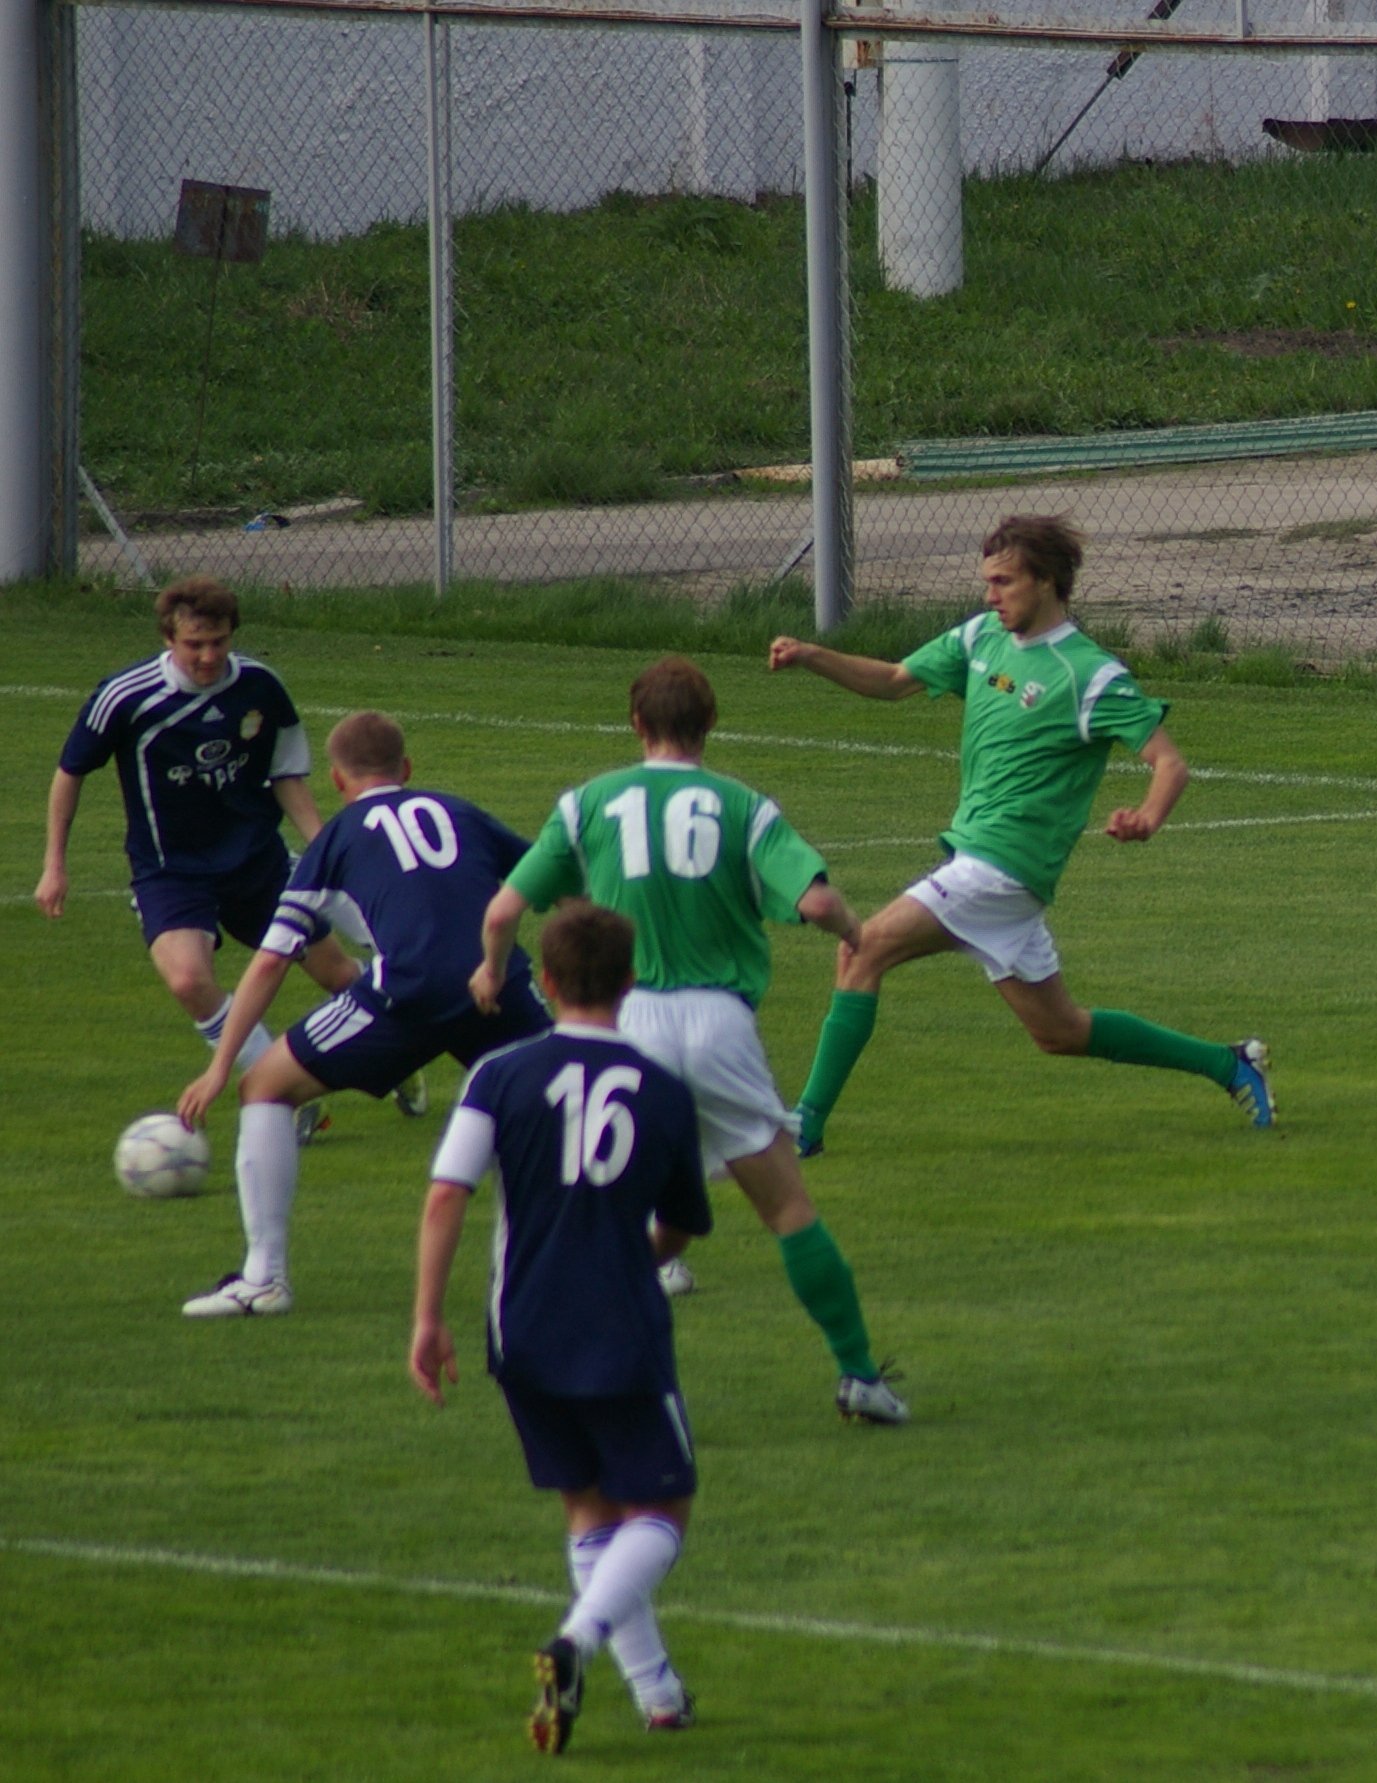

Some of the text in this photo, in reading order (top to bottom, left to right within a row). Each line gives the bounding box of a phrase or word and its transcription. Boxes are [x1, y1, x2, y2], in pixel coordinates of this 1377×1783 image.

[362, 796, 459, 873] 10
[603, 785, 721, 880] 16
[544, 1061, 643, 1188] 16
